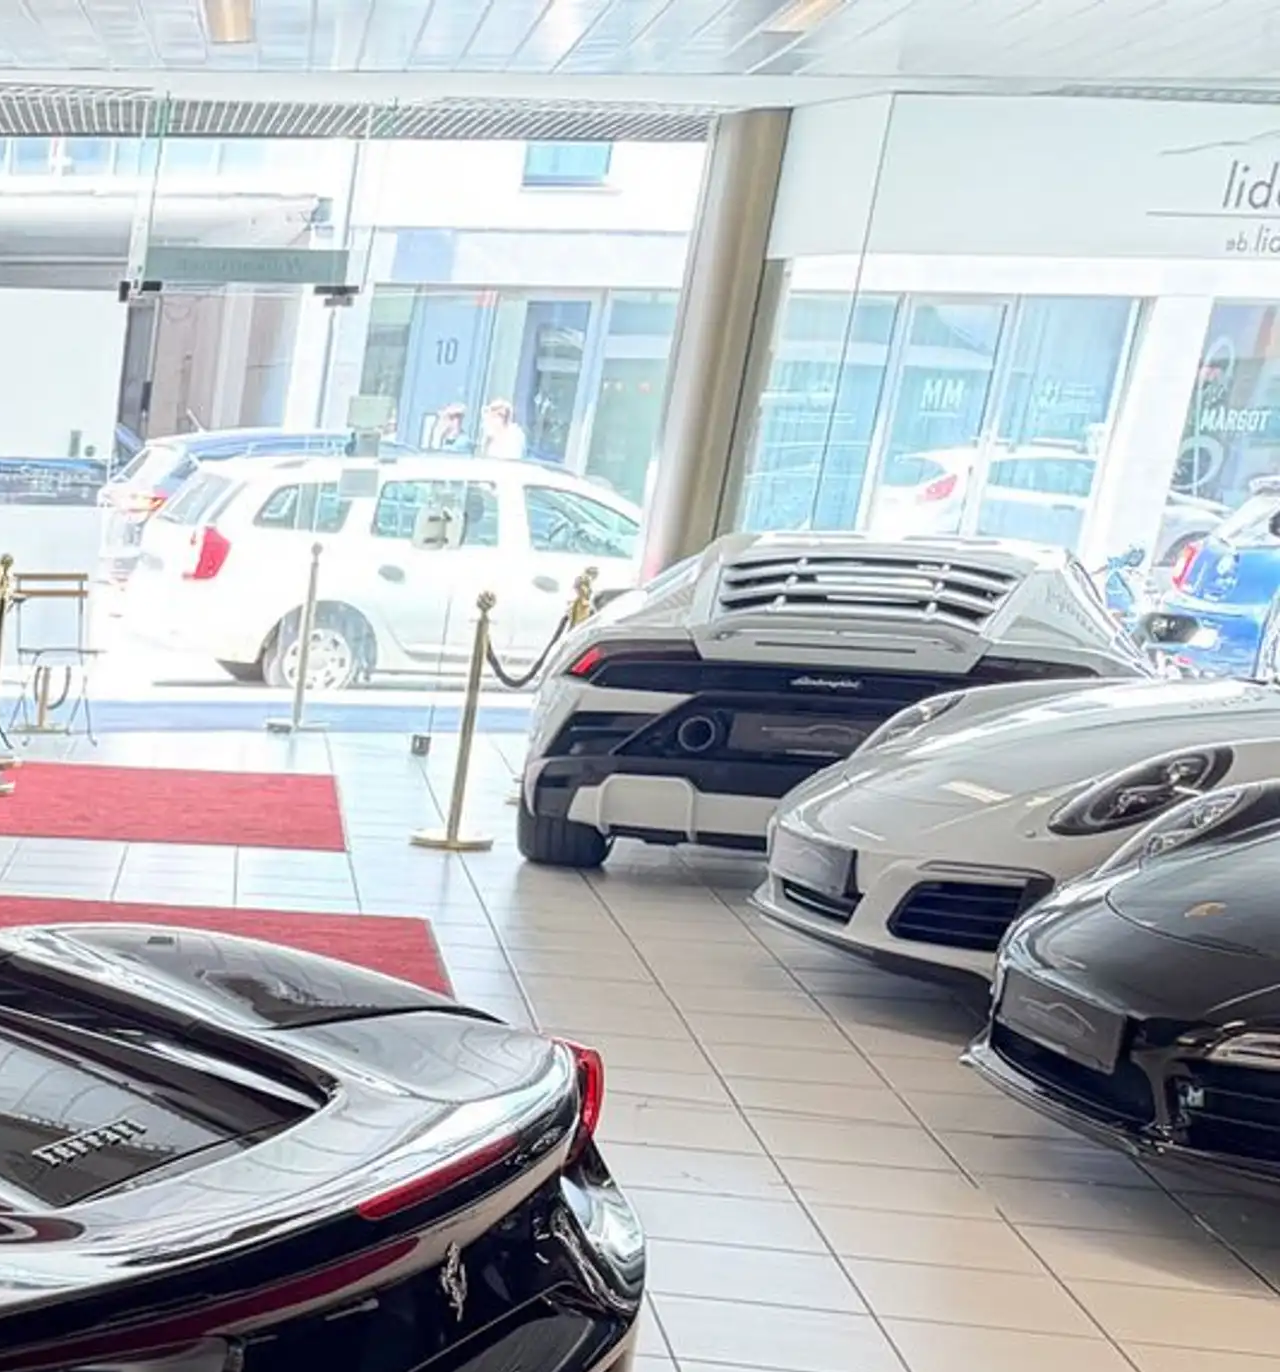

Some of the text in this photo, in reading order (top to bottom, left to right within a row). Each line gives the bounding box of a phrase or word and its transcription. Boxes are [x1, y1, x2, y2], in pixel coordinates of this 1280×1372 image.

[436, 337, 460, 366] 10
[1200, 406, 1271, 431] MARGOT
[31, 1115, 148, 1168] Ferrari
